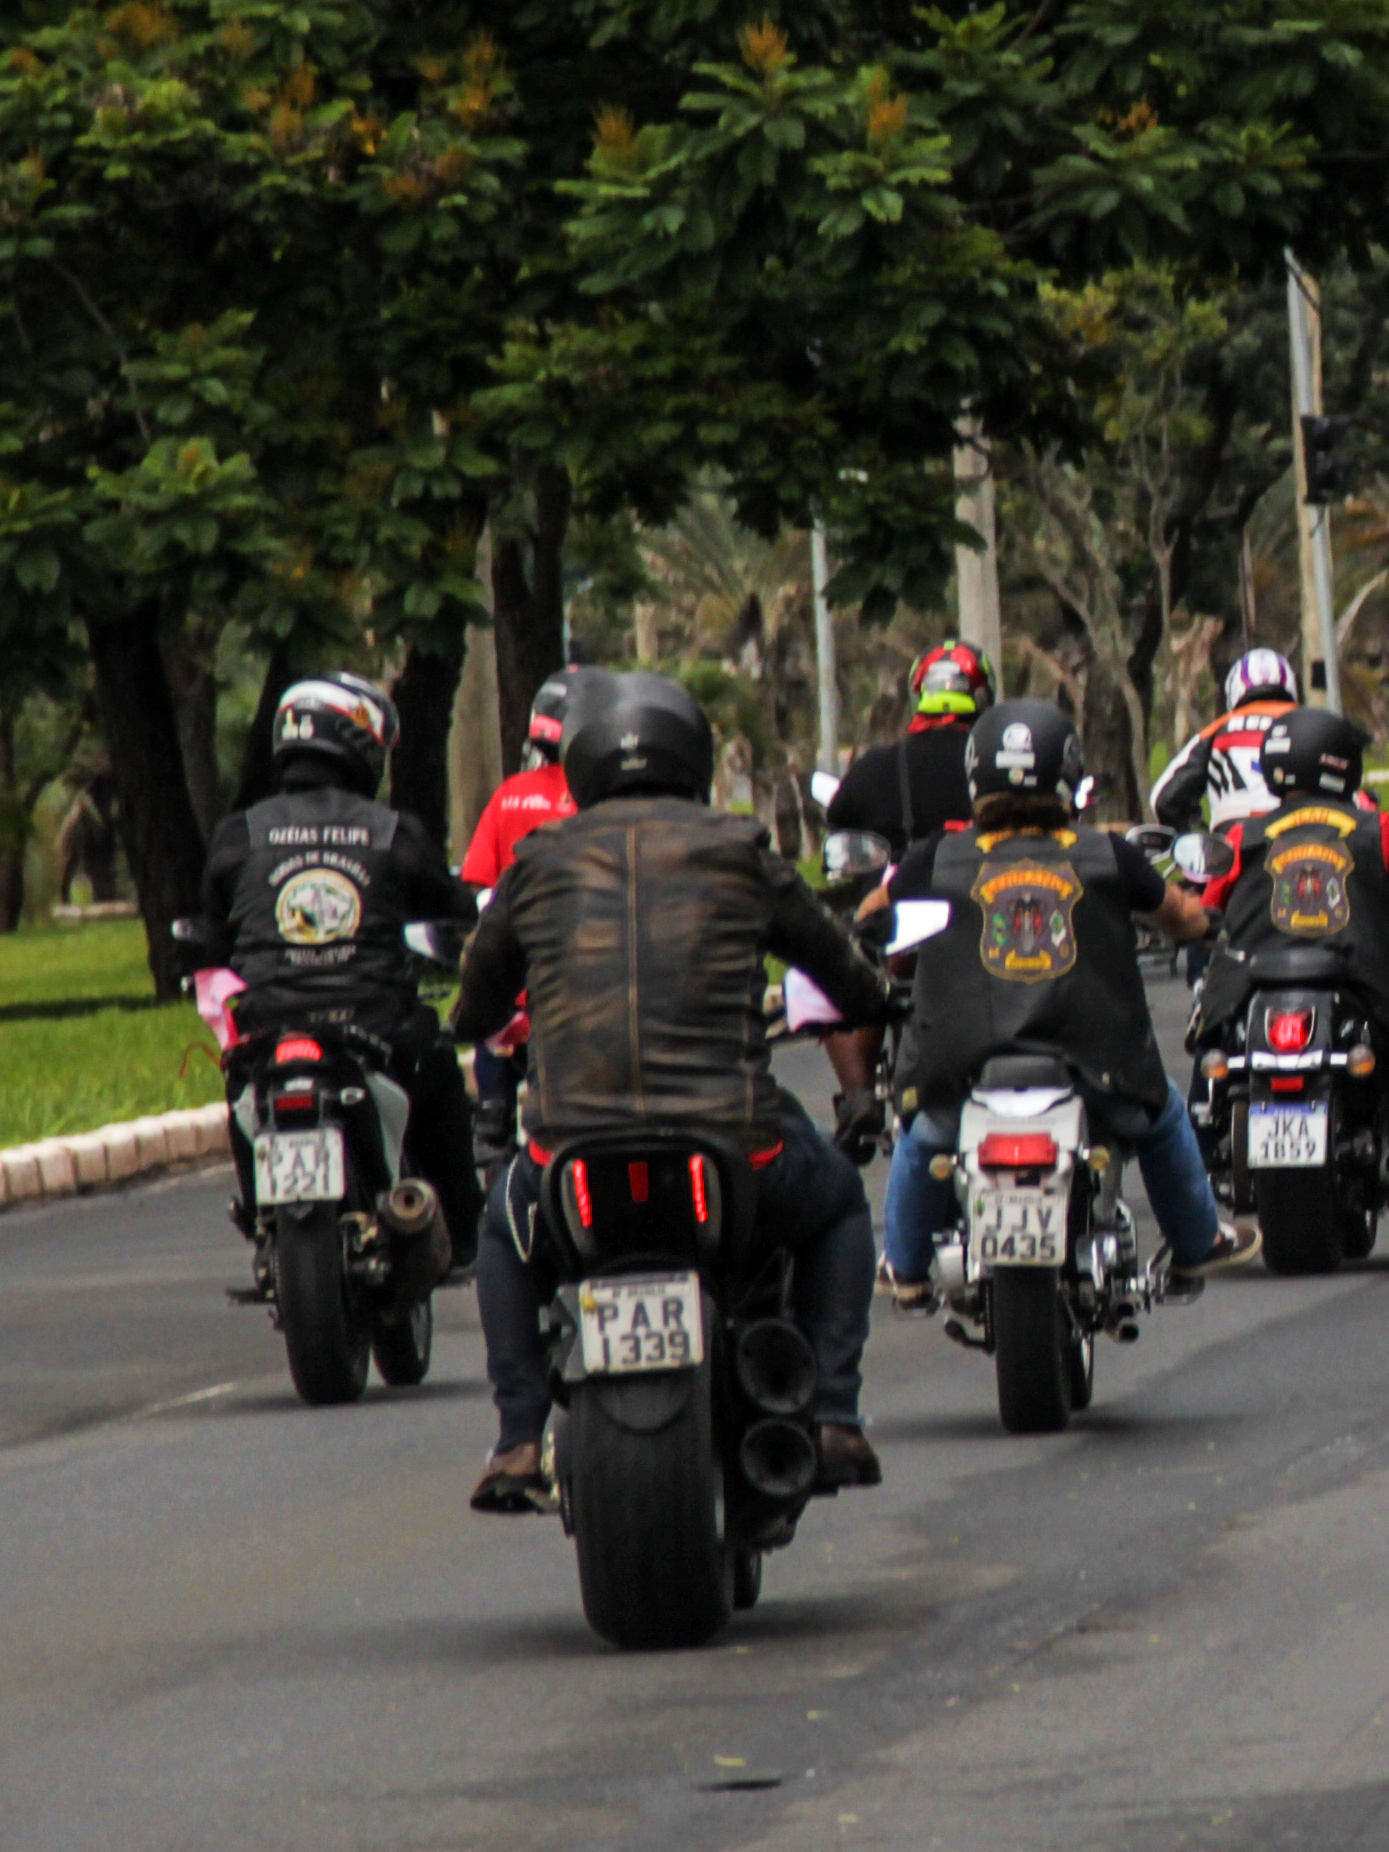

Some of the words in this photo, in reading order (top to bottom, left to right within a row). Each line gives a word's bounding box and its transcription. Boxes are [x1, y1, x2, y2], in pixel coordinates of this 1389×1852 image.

[323, 826, 370, 846] FELIPE
[1267, 1113, 1309, 1140] JKA
[985, 1205, 1054, 1234] JJV
[980, 1233, 1057, 1260] 0435
[597, 1297, 685, 1333] PAR
[601, 1331, 691, 1371] 1339
